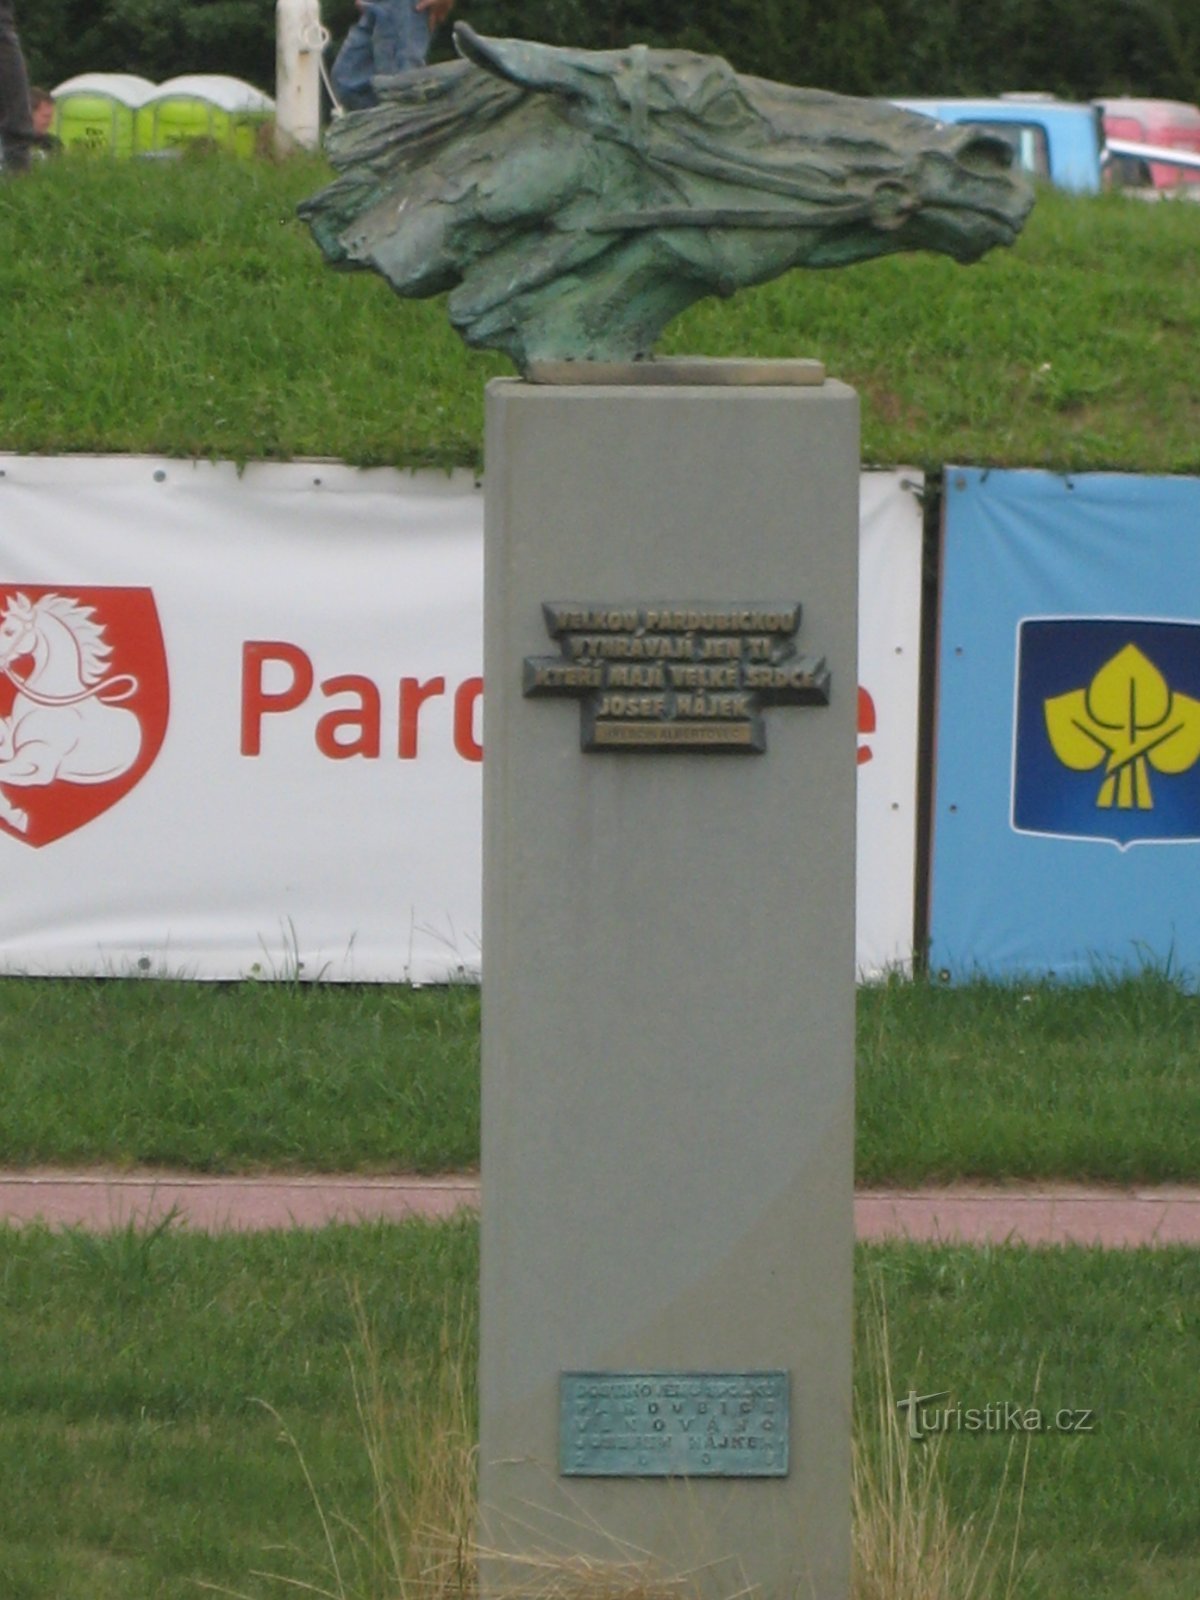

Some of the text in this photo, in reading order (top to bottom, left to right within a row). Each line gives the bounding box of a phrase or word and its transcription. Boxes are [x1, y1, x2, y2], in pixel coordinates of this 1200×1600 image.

[703, 638, 741, 658] JEN
[600, 688, 748, 717] JOSEF HÁJEK
